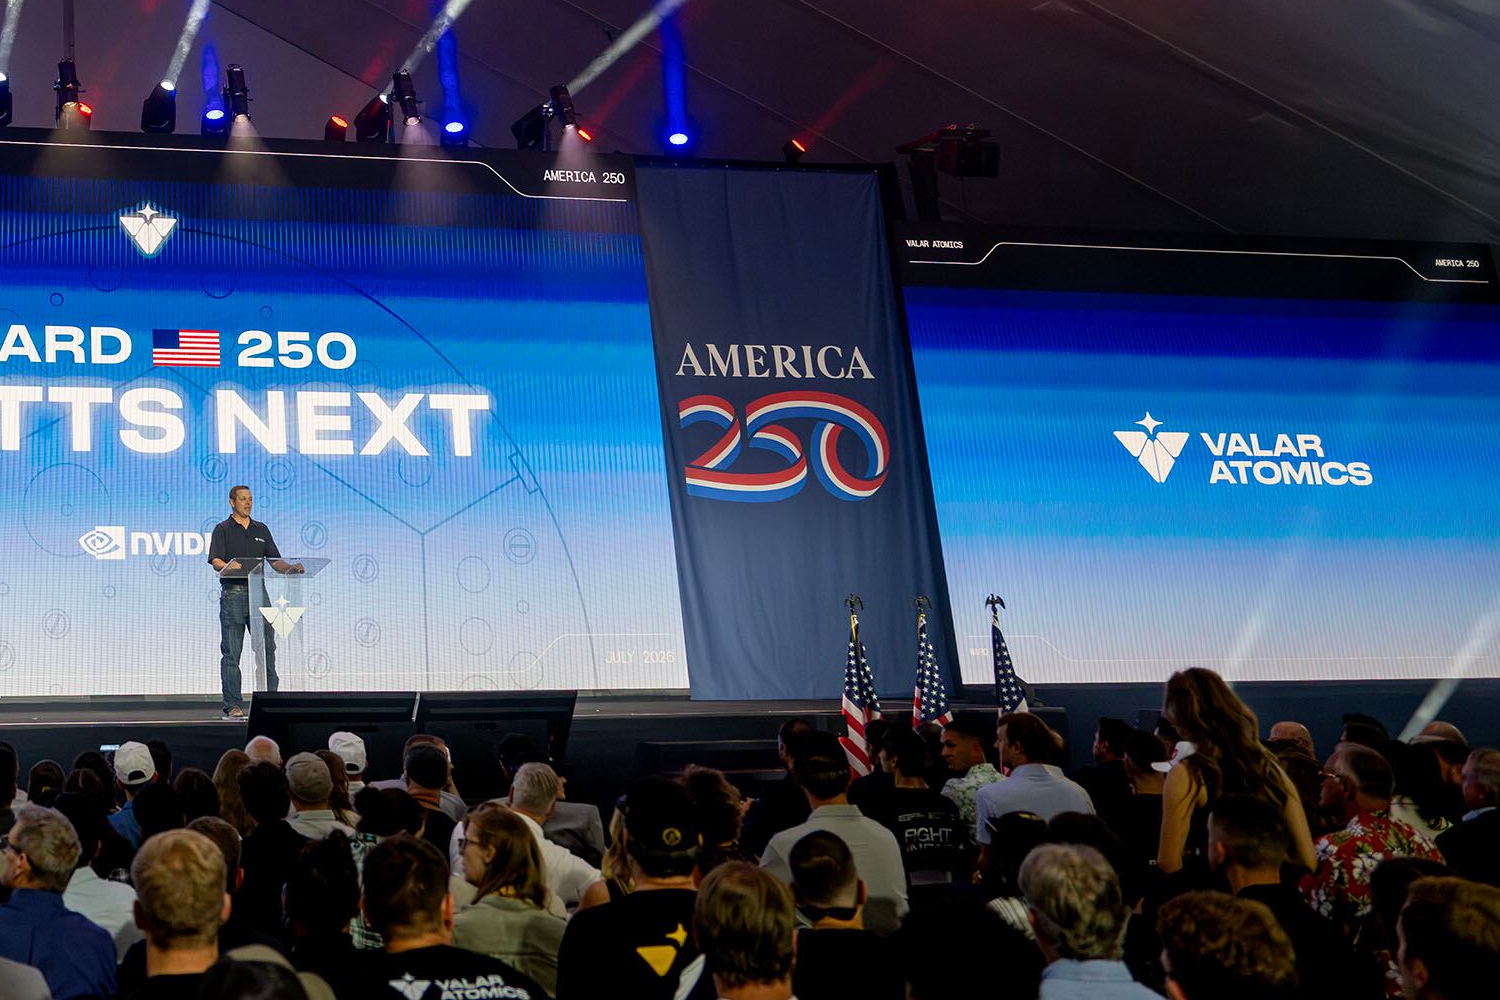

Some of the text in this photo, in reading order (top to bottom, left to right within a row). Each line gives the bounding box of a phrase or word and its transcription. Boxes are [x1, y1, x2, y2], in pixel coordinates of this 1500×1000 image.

[543, 169, 625, 184] AMERICA 250
[905, 239, 964, 249] VALAR ATOMICS
[1435, 259, 1480, 268] AMERICA 250
[237, 330, 357, 370] 250
[675, 342, 876, 379] AMERICA
[217, 389, 489, 457] NEXT
[678, 390, 890, 503] 250
[1200, 432, 1325, 458] VALAR
[1209, 460, 1374, 486] ATOMICS
[131, 532, 212, 556] NVIDI
[605, 650, 676, 664] JULY 2026
[434, 974, 504, 991] VALAR
